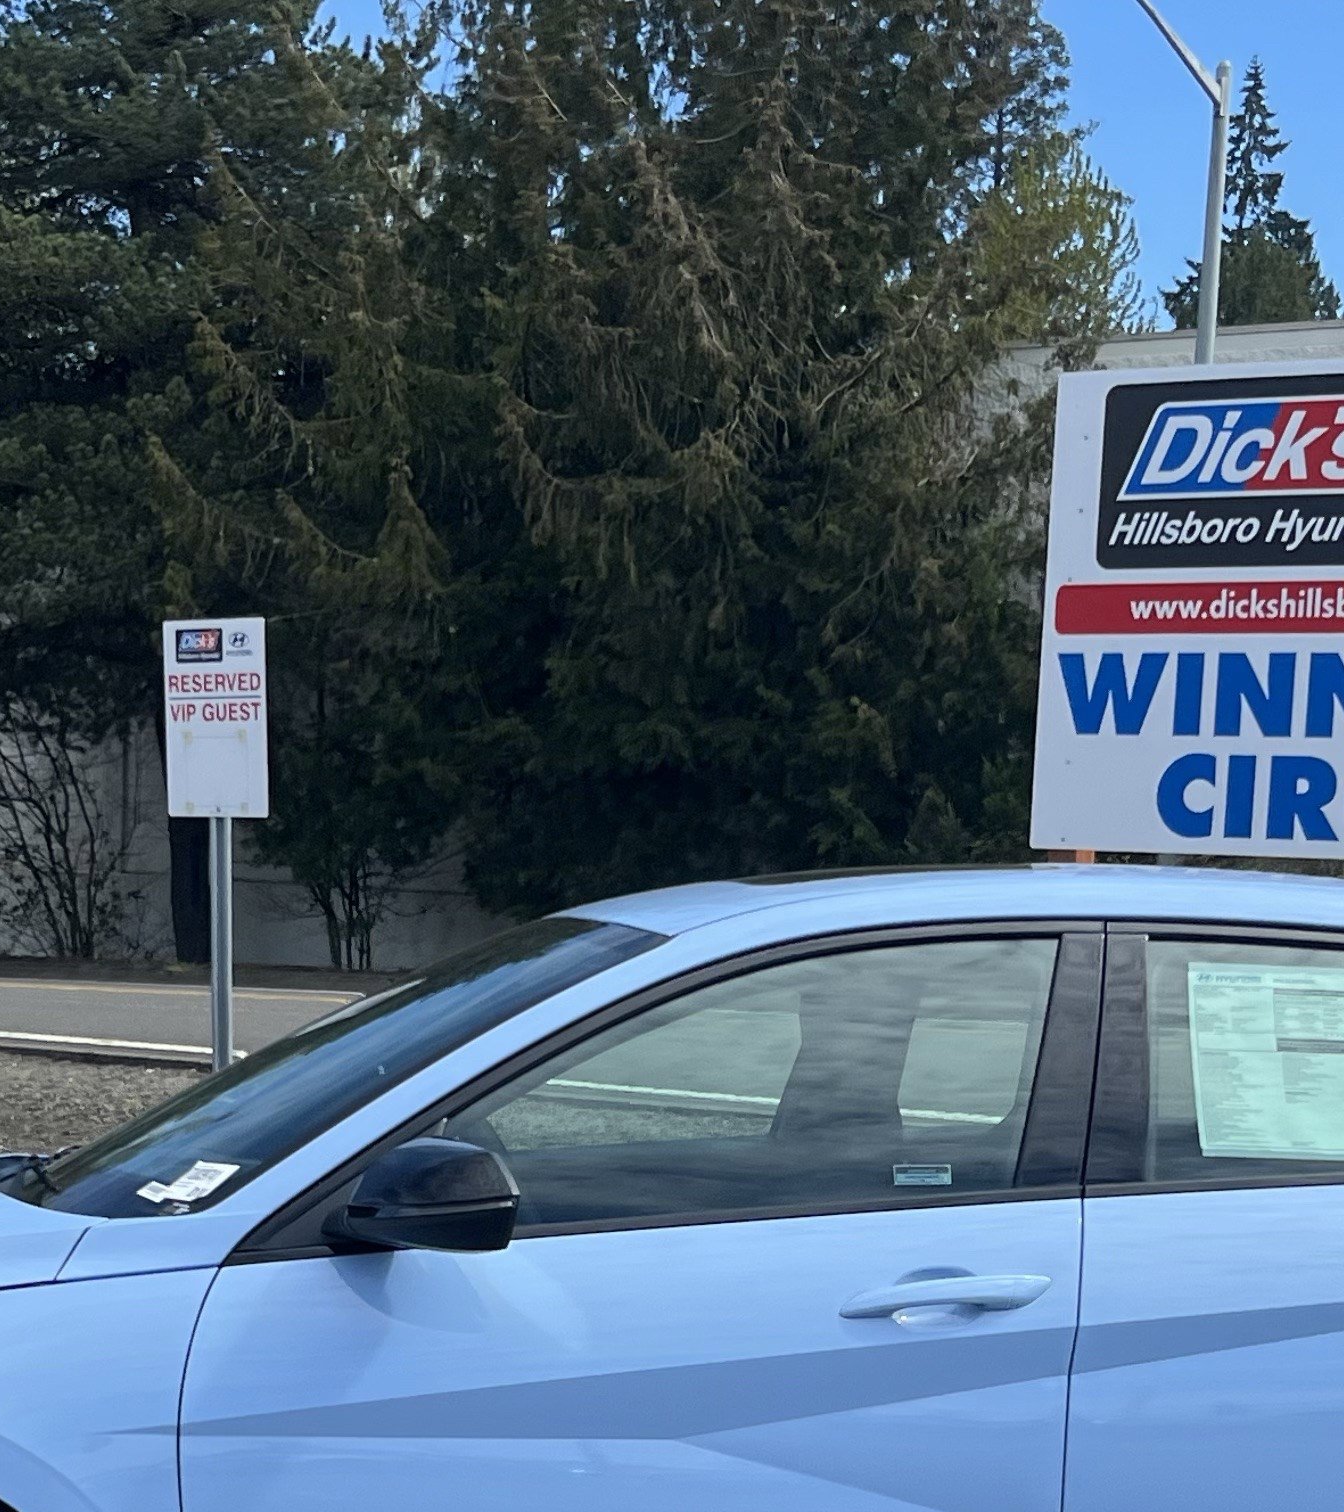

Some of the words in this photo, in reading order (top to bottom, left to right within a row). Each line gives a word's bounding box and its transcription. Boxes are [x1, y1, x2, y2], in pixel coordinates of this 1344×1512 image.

[1108, 508, 1261, 546] Hillsboro
[168, 672, 261, 693] RESERVED
[170, 703, 197, 722] VIP
[202, 702, 261, 722] GUEST
